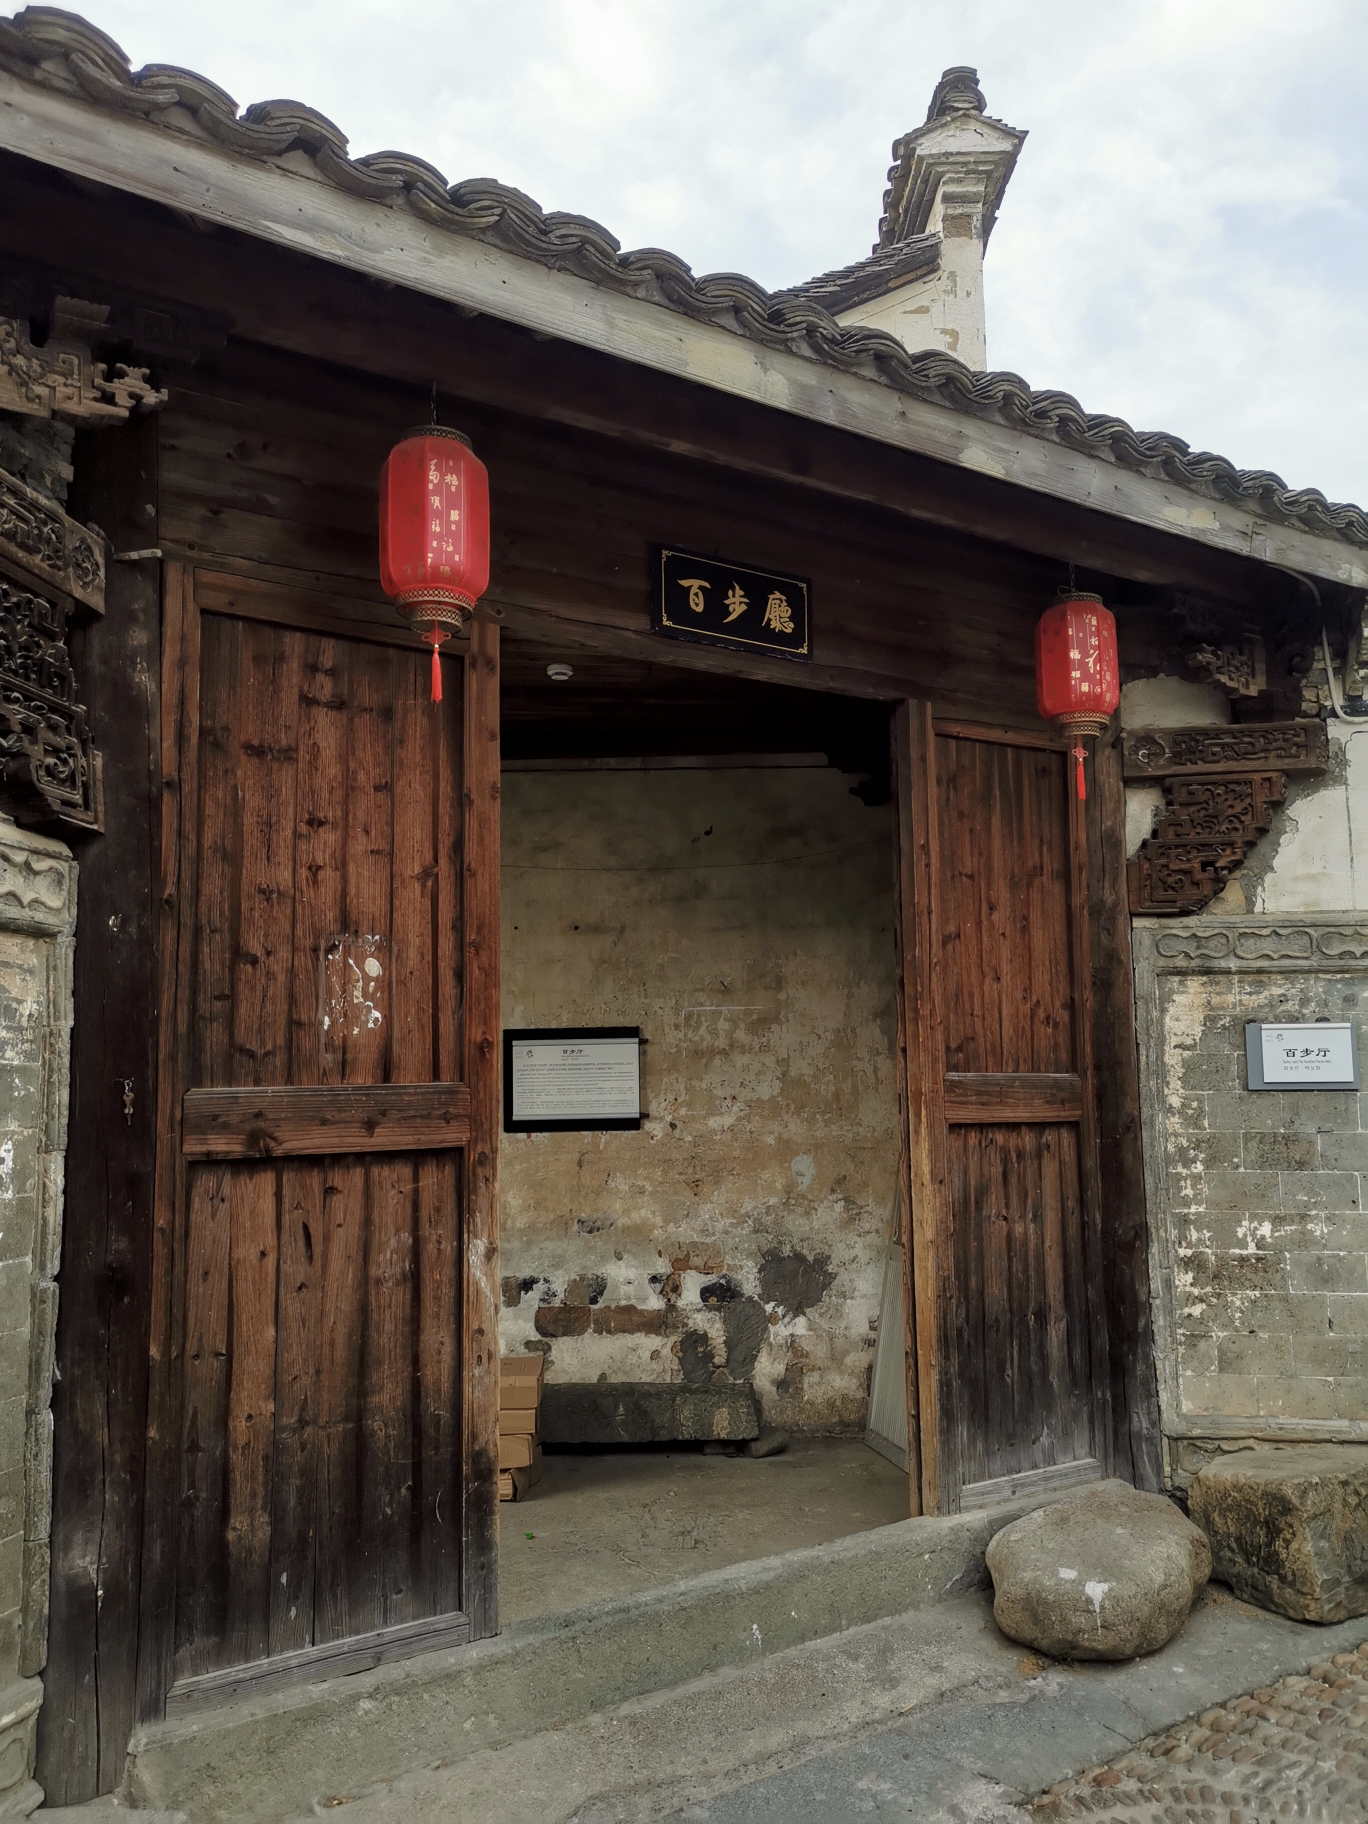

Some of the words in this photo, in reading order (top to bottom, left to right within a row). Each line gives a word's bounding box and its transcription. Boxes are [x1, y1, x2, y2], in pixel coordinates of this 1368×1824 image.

[676, 578, 795, 634] 百步廳
[1283, 1047, 1330, 1057] 百步厅
